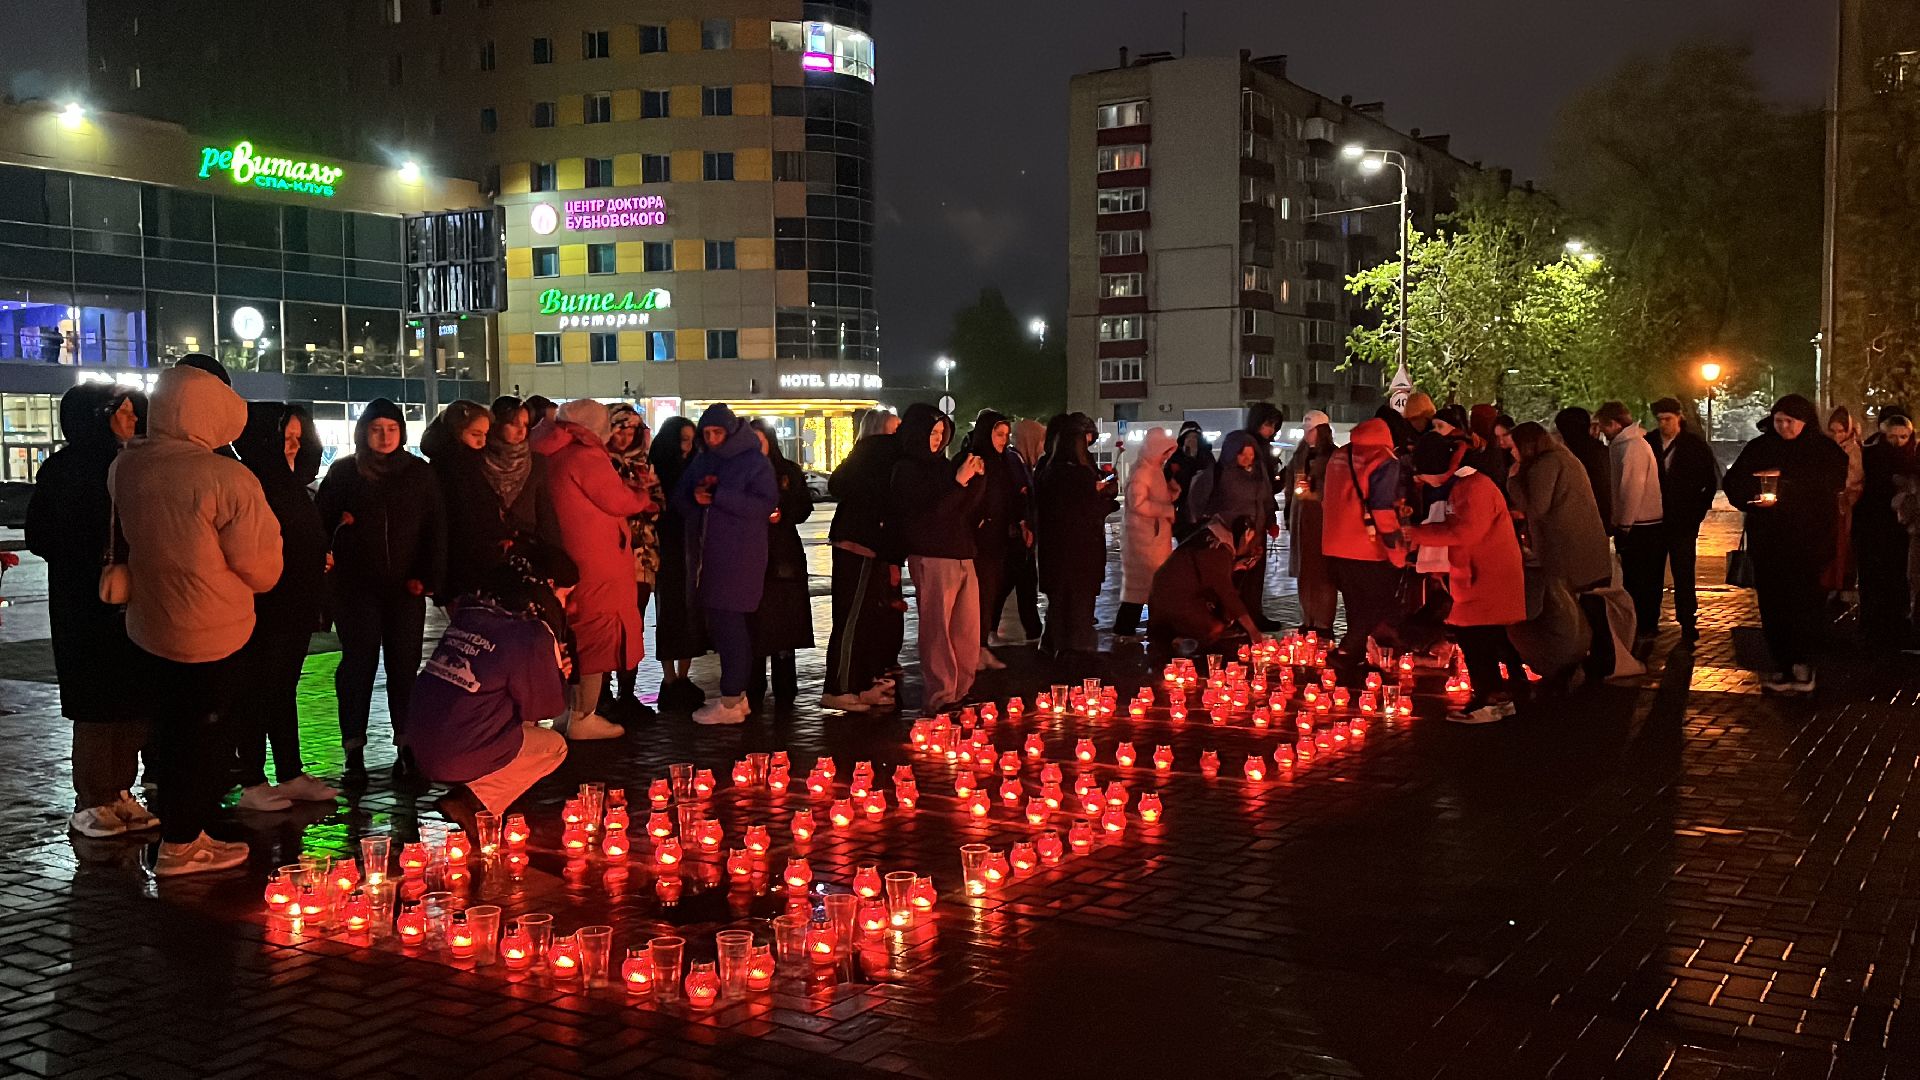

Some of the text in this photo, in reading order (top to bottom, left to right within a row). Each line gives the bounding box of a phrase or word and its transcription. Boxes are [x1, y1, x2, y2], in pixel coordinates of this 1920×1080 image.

[255, 175, 336, 197] СПА-КЛУБ
[565, 195, 665, 214] ЦЕНТР ДОКТОРА
[565, 211, 665, 230] БУБНОВСКОГО
[559, 313, 650, 329] ресторан
[780, 374, 825, 387] HOTEL
[829, 373, 860, 387] EAST
